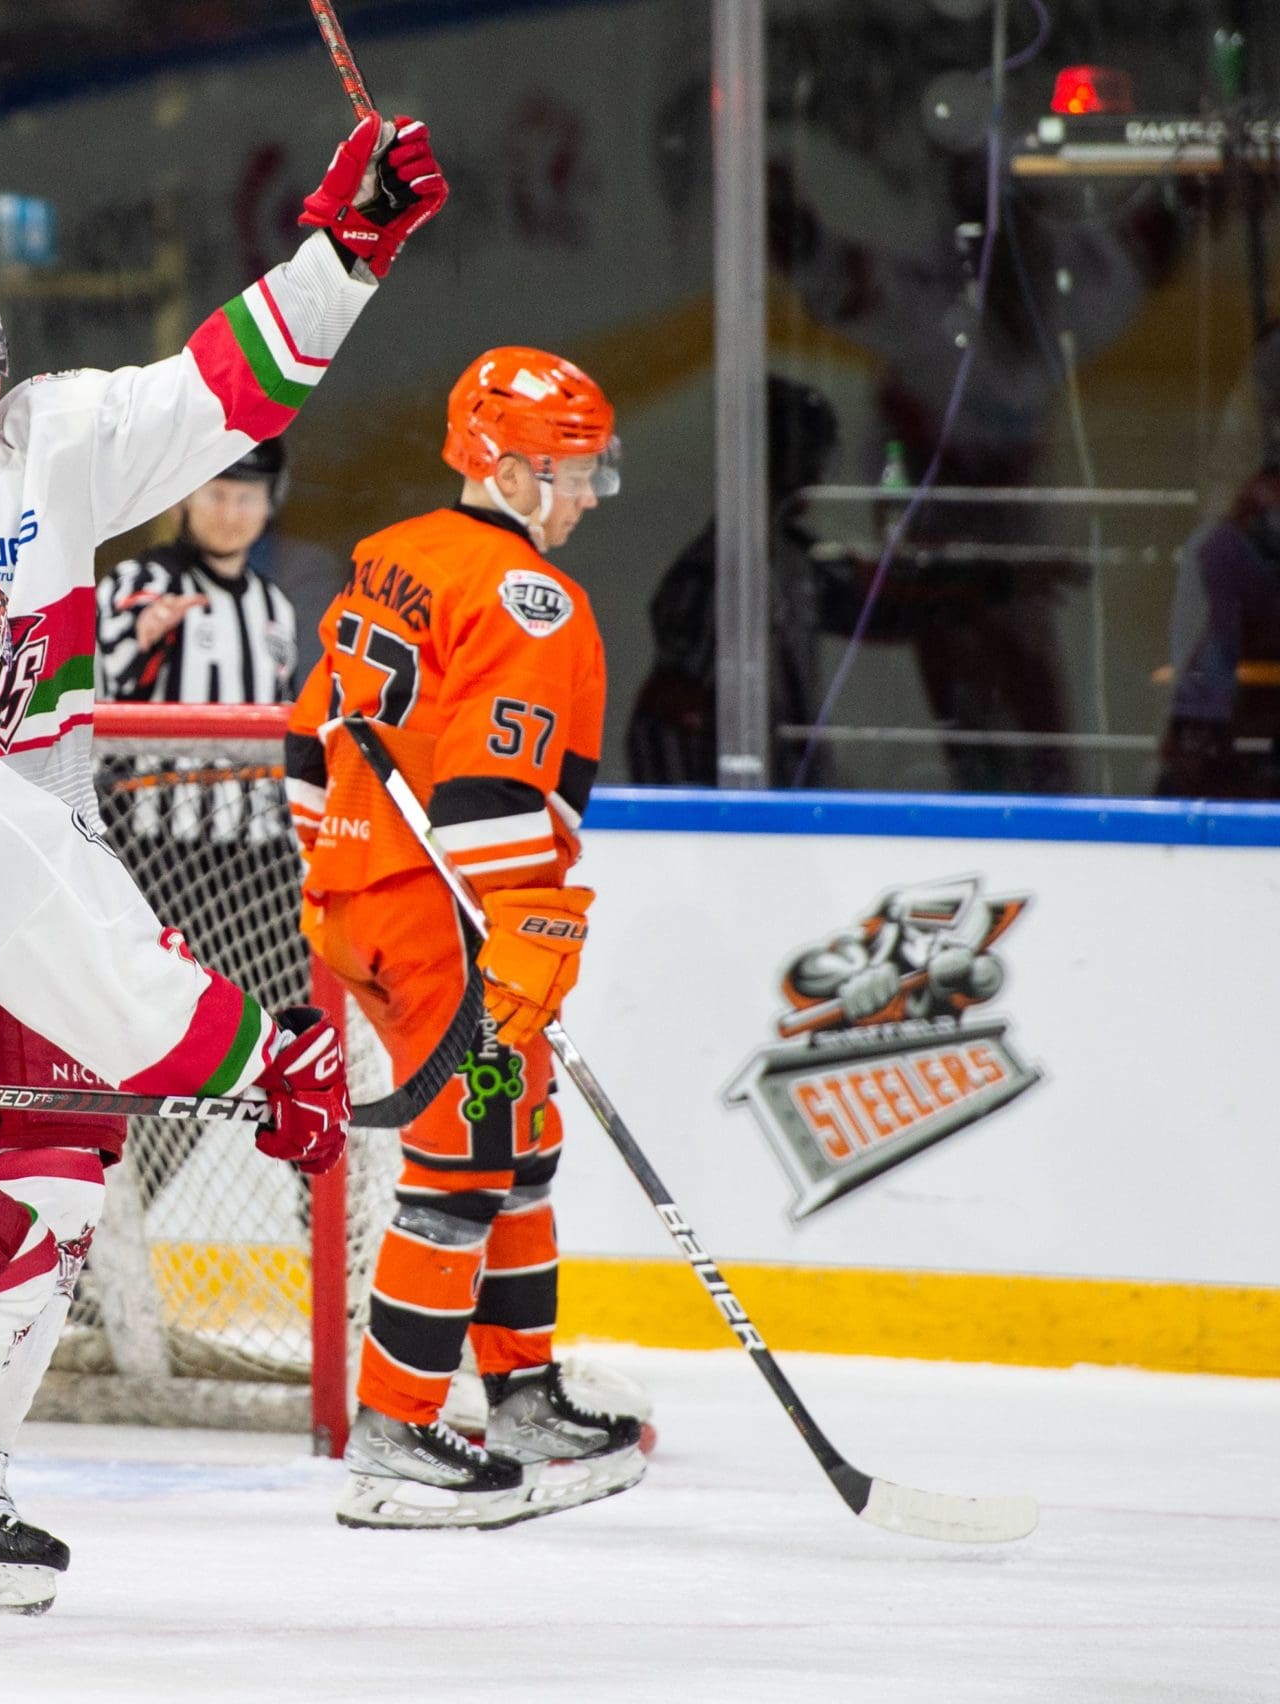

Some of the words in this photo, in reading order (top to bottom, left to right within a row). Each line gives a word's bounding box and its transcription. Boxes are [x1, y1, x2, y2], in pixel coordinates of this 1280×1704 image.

[342, 230, 380, 243] CCM
[486, 696, 558, 768] 57
[519, 916, 589, 941] BAU
[158, 1096, 272, 1124] CCM
[796, 1045, 1006, 1159] STEELERS
[654, 1202, 769, 1351] BAUER
